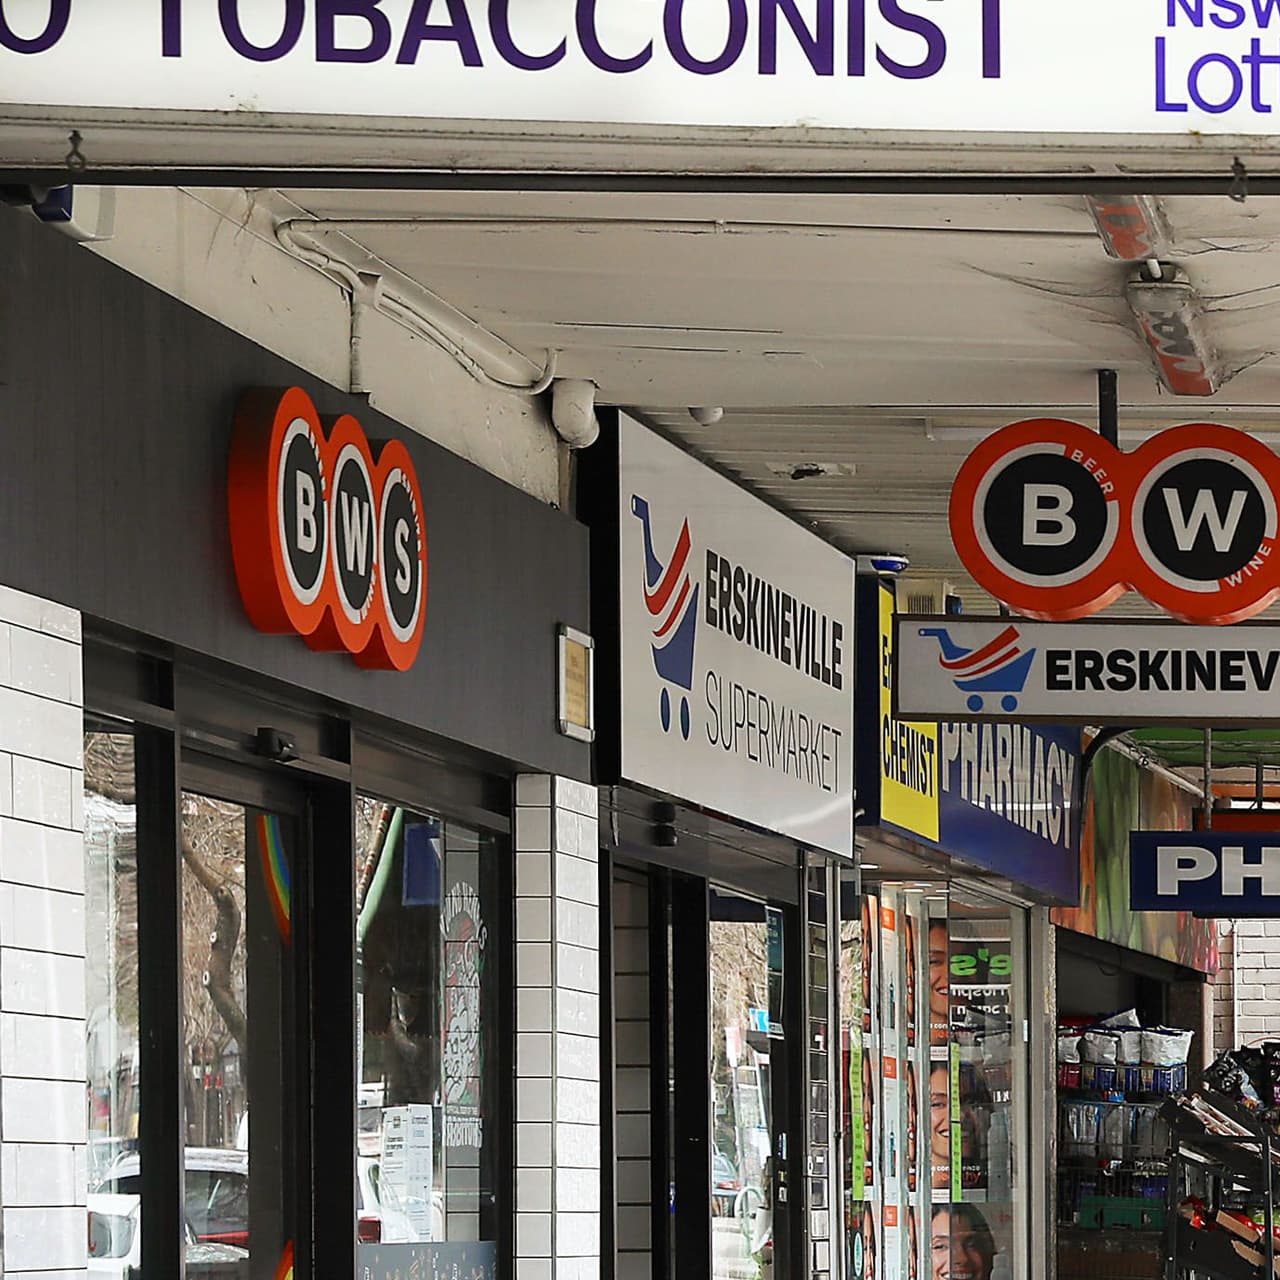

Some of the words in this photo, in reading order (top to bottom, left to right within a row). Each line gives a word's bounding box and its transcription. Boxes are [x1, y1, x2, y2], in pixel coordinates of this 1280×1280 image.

[296, 469, 411, 595] BWS
[1070, 448, 1112, 495] BEER
[705, 548, 843, 693] ERSKINEVILLE
[1224, 542, 1273, 588] WINE
[705, 669, 843, 794] SUPERMARKET
[883, 714, 935, 798] CHEMIST
[942, 723, 1075, 849] PHARMACY
